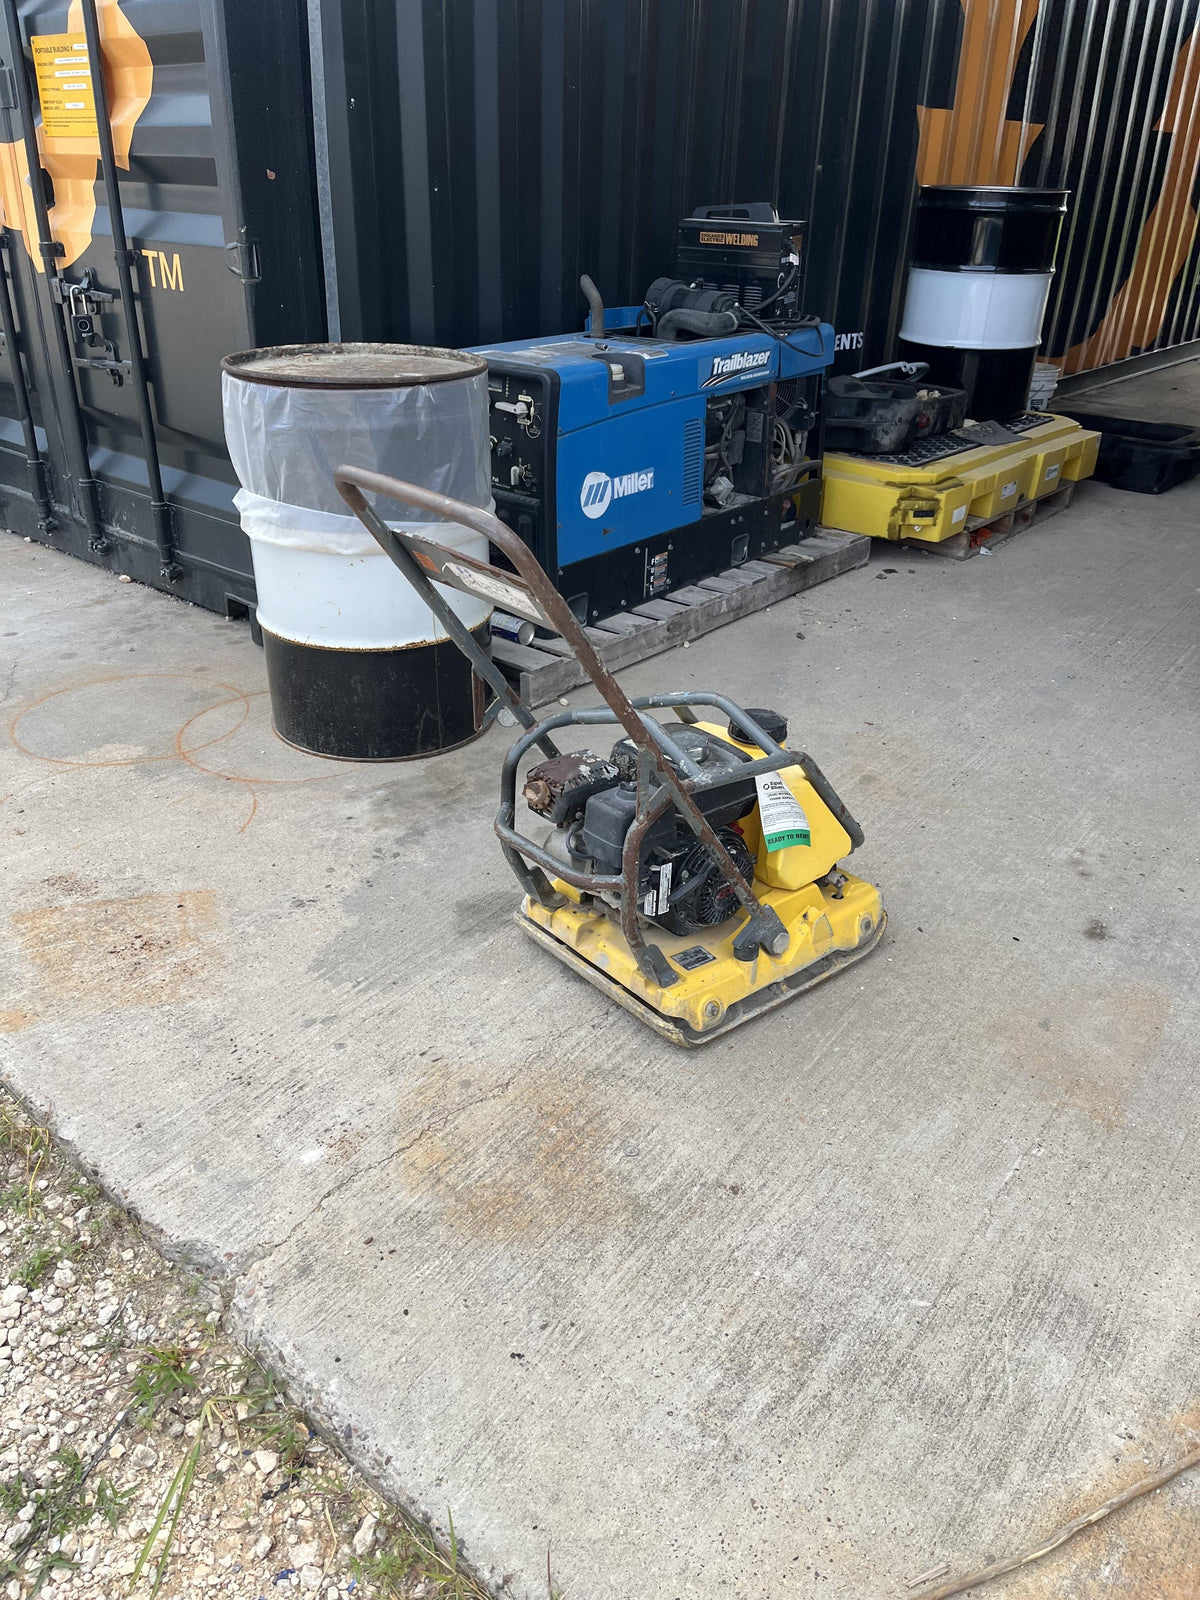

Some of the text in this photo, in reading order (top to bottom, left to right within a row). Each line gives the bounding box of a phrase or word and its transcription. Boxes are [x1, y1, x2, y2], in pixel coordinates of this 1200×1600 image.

[34, 46, 53, 54] PORTABLE
[53, 45, 70, 53] BUILDING
[725, 233, 759, 246] WELDING
[141, 249, 185, 292] TM
[834, 331, 864, 352] ENTS
[712, 350, 771, 375] Trailblazer
[613, 472, 654, 500] Miller
[767, 835, 786, 845] READY
